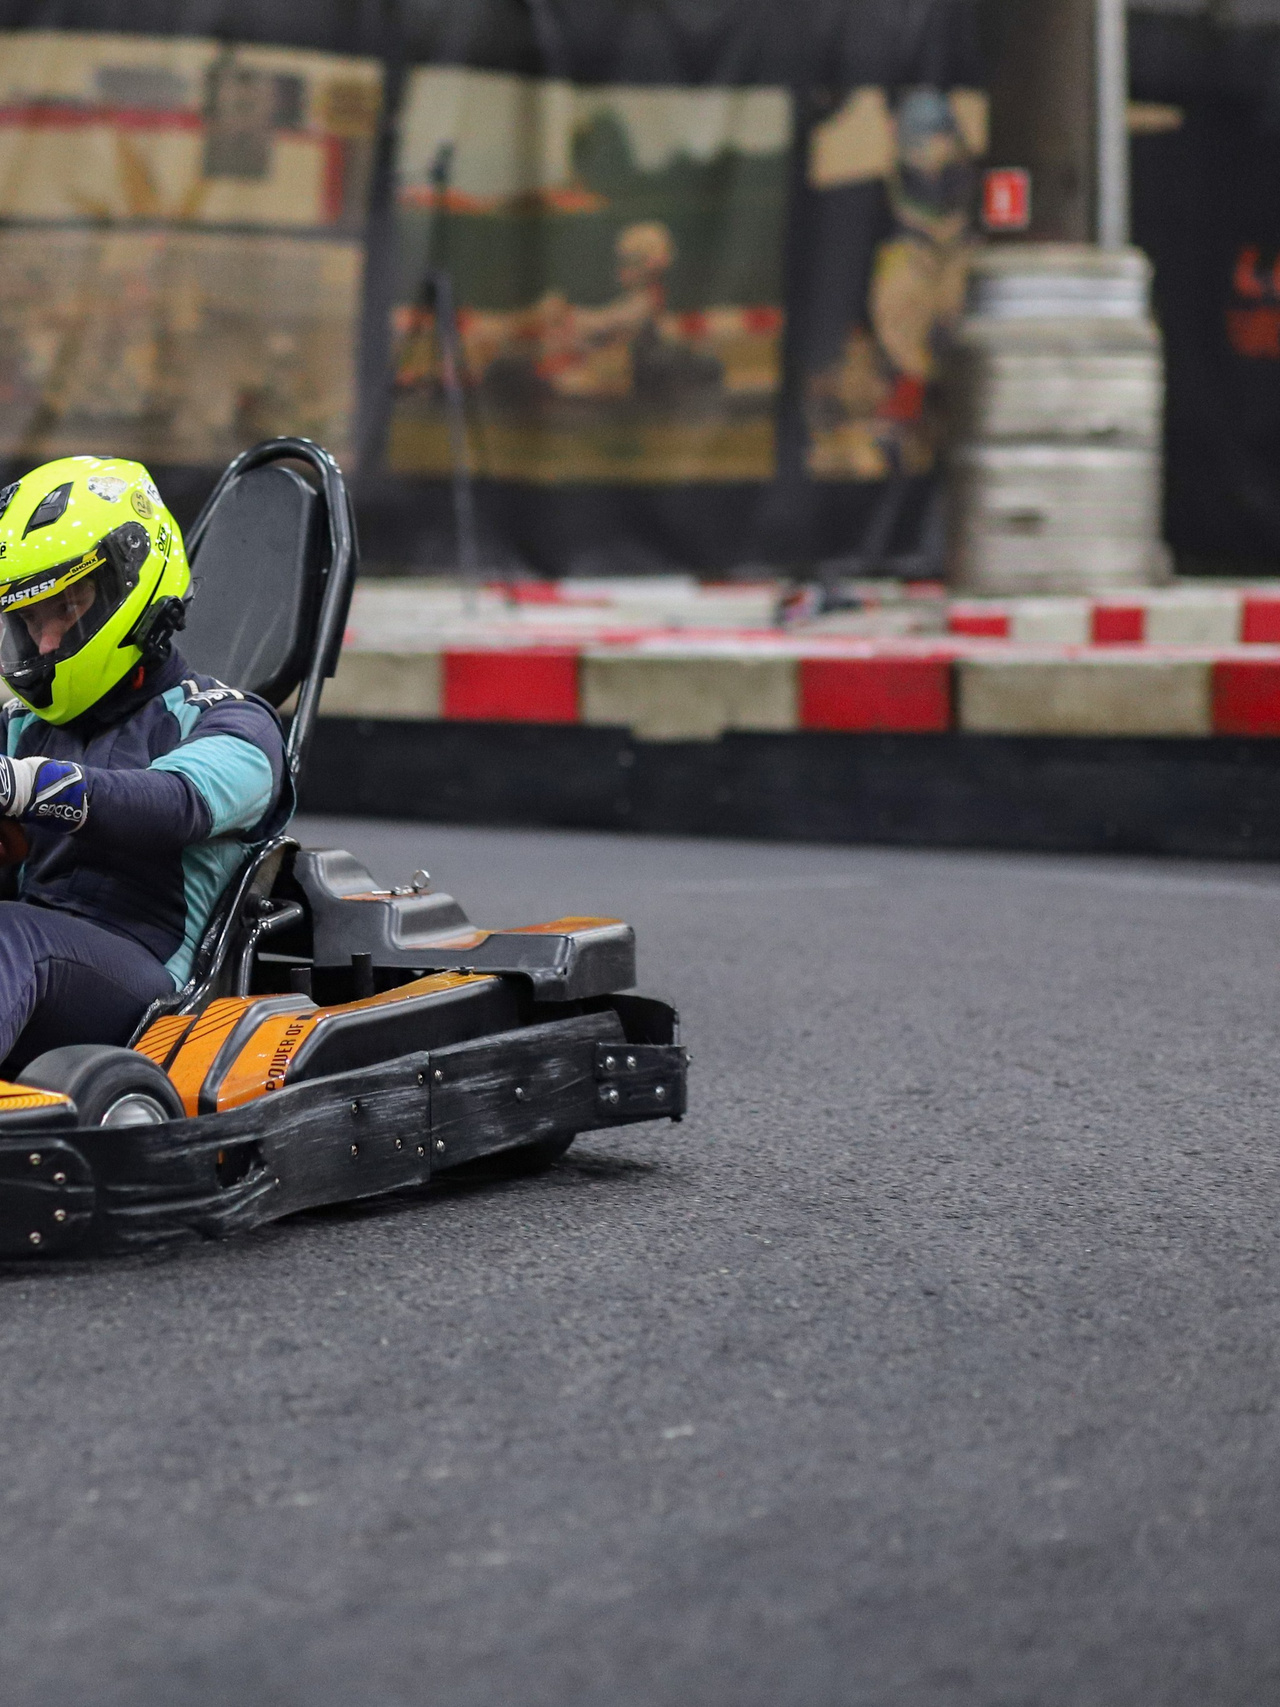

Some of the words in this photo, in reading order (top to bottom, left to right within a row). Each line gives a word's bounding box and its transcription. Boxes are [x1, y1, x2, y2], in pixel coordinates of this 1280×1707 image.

[1, 578, 57, 606] FASTEST
[265, 1039, 297, 1092] POWER
[285, 1024, 305, 1036] OF
